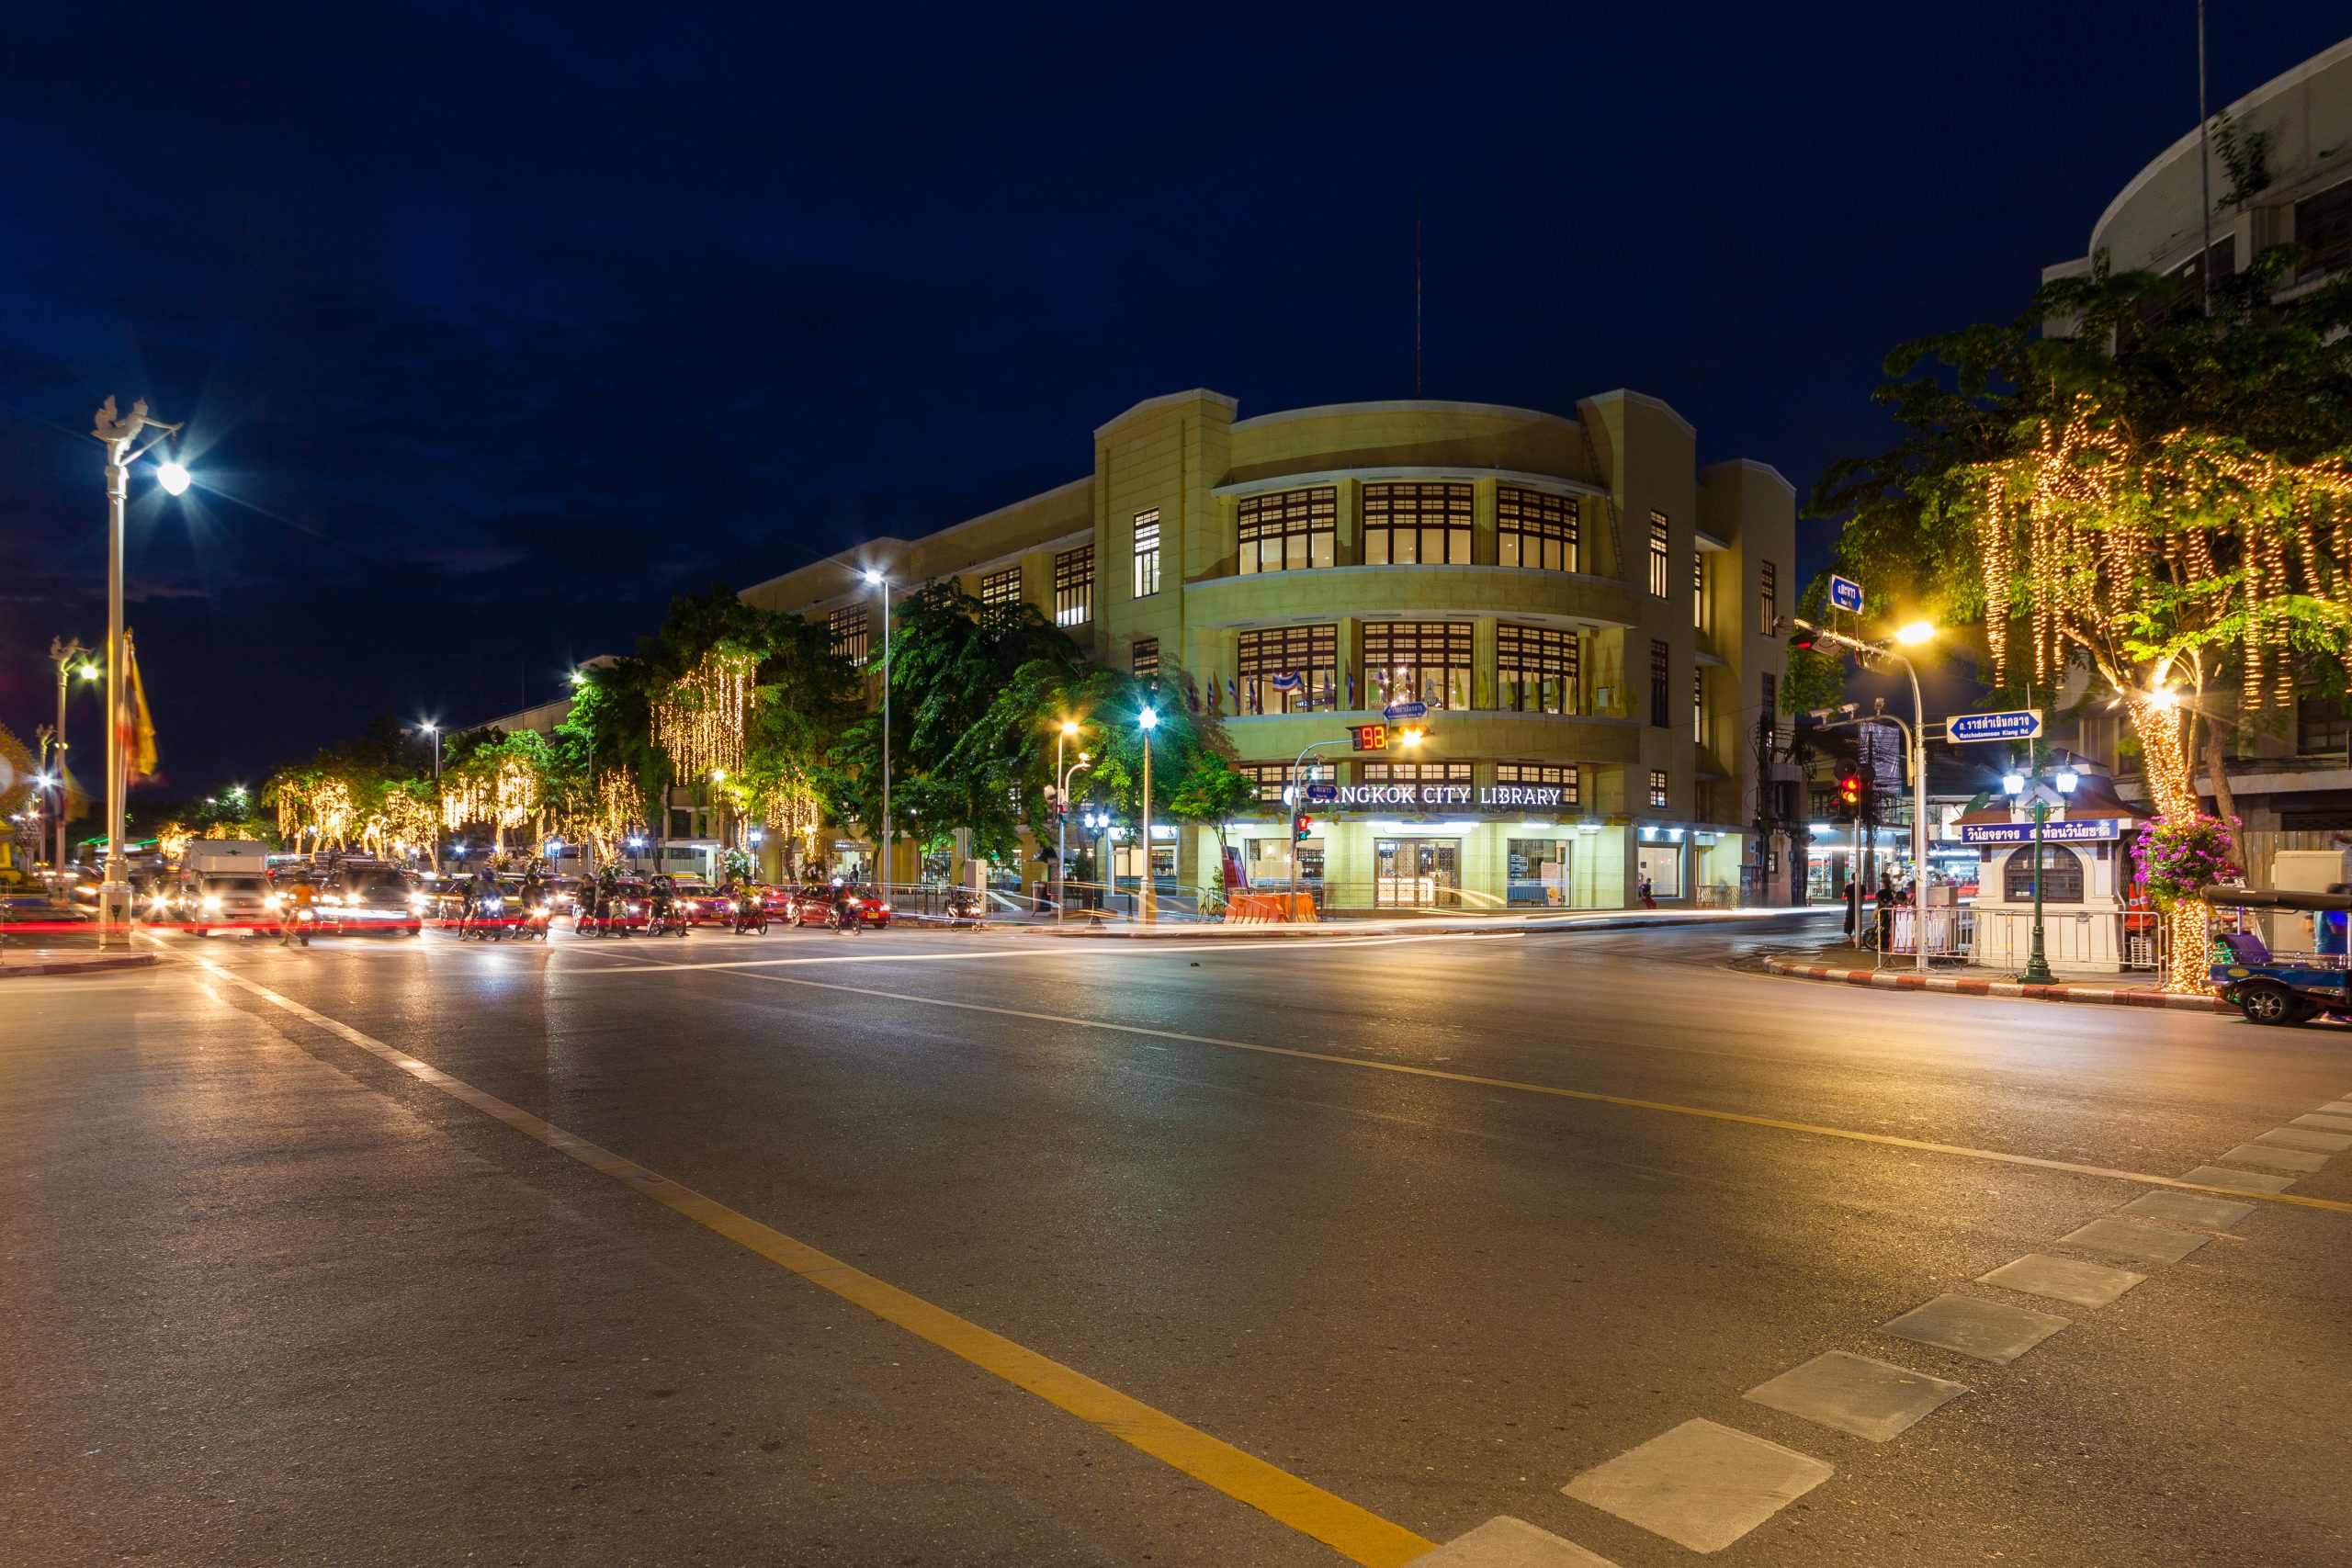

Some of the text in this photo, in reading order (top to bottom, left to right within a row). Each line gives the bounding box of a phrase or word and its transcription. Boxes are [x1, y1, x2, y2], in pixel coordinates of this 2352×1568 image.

[1312, 786, 1561, 806] NGKOK CITY LIBRARY
[1967, 828, 2020, 840] วินัยจราจร
